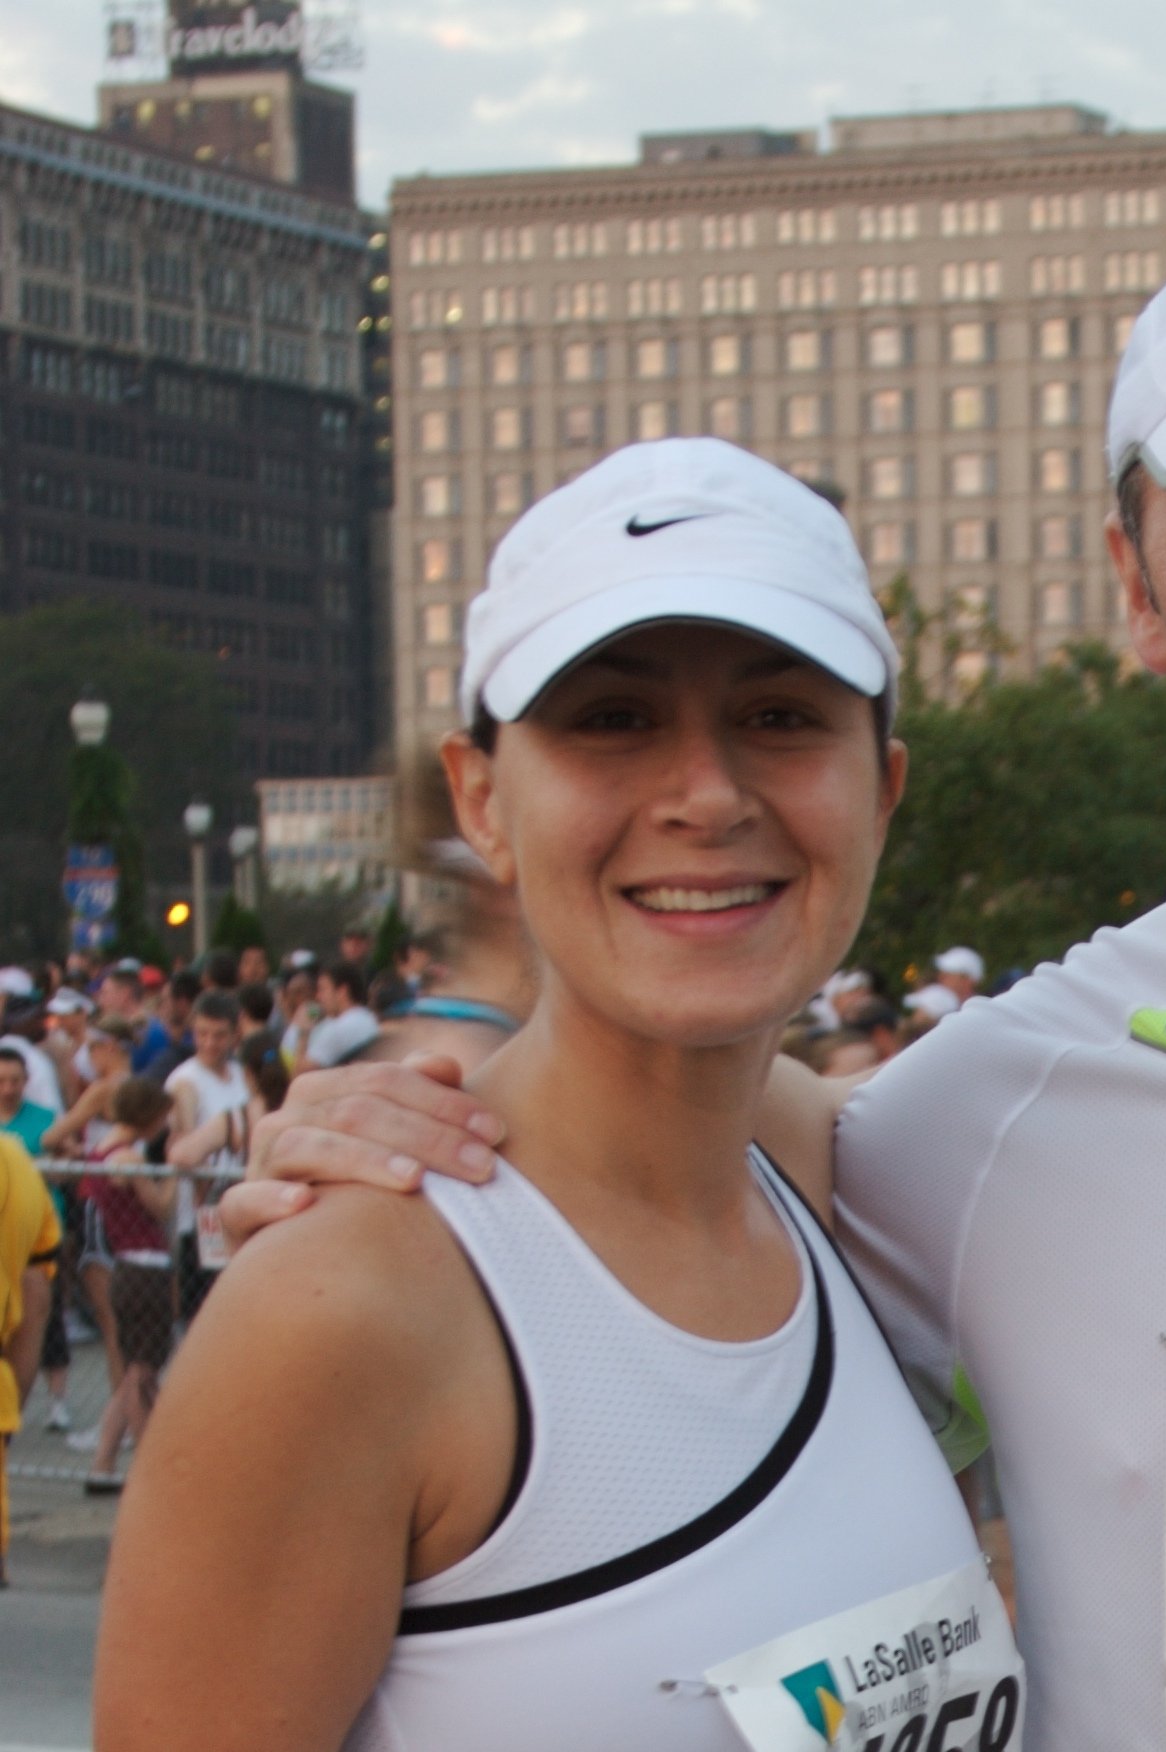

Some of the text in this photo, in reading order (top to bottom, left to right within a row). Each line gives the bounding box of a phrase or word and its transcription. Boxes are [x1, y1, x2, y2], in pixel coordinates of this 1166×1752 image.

[843, 1604, 982, 1693] LaSalle Bank
[857, 1702, 887, 1732] ABN
